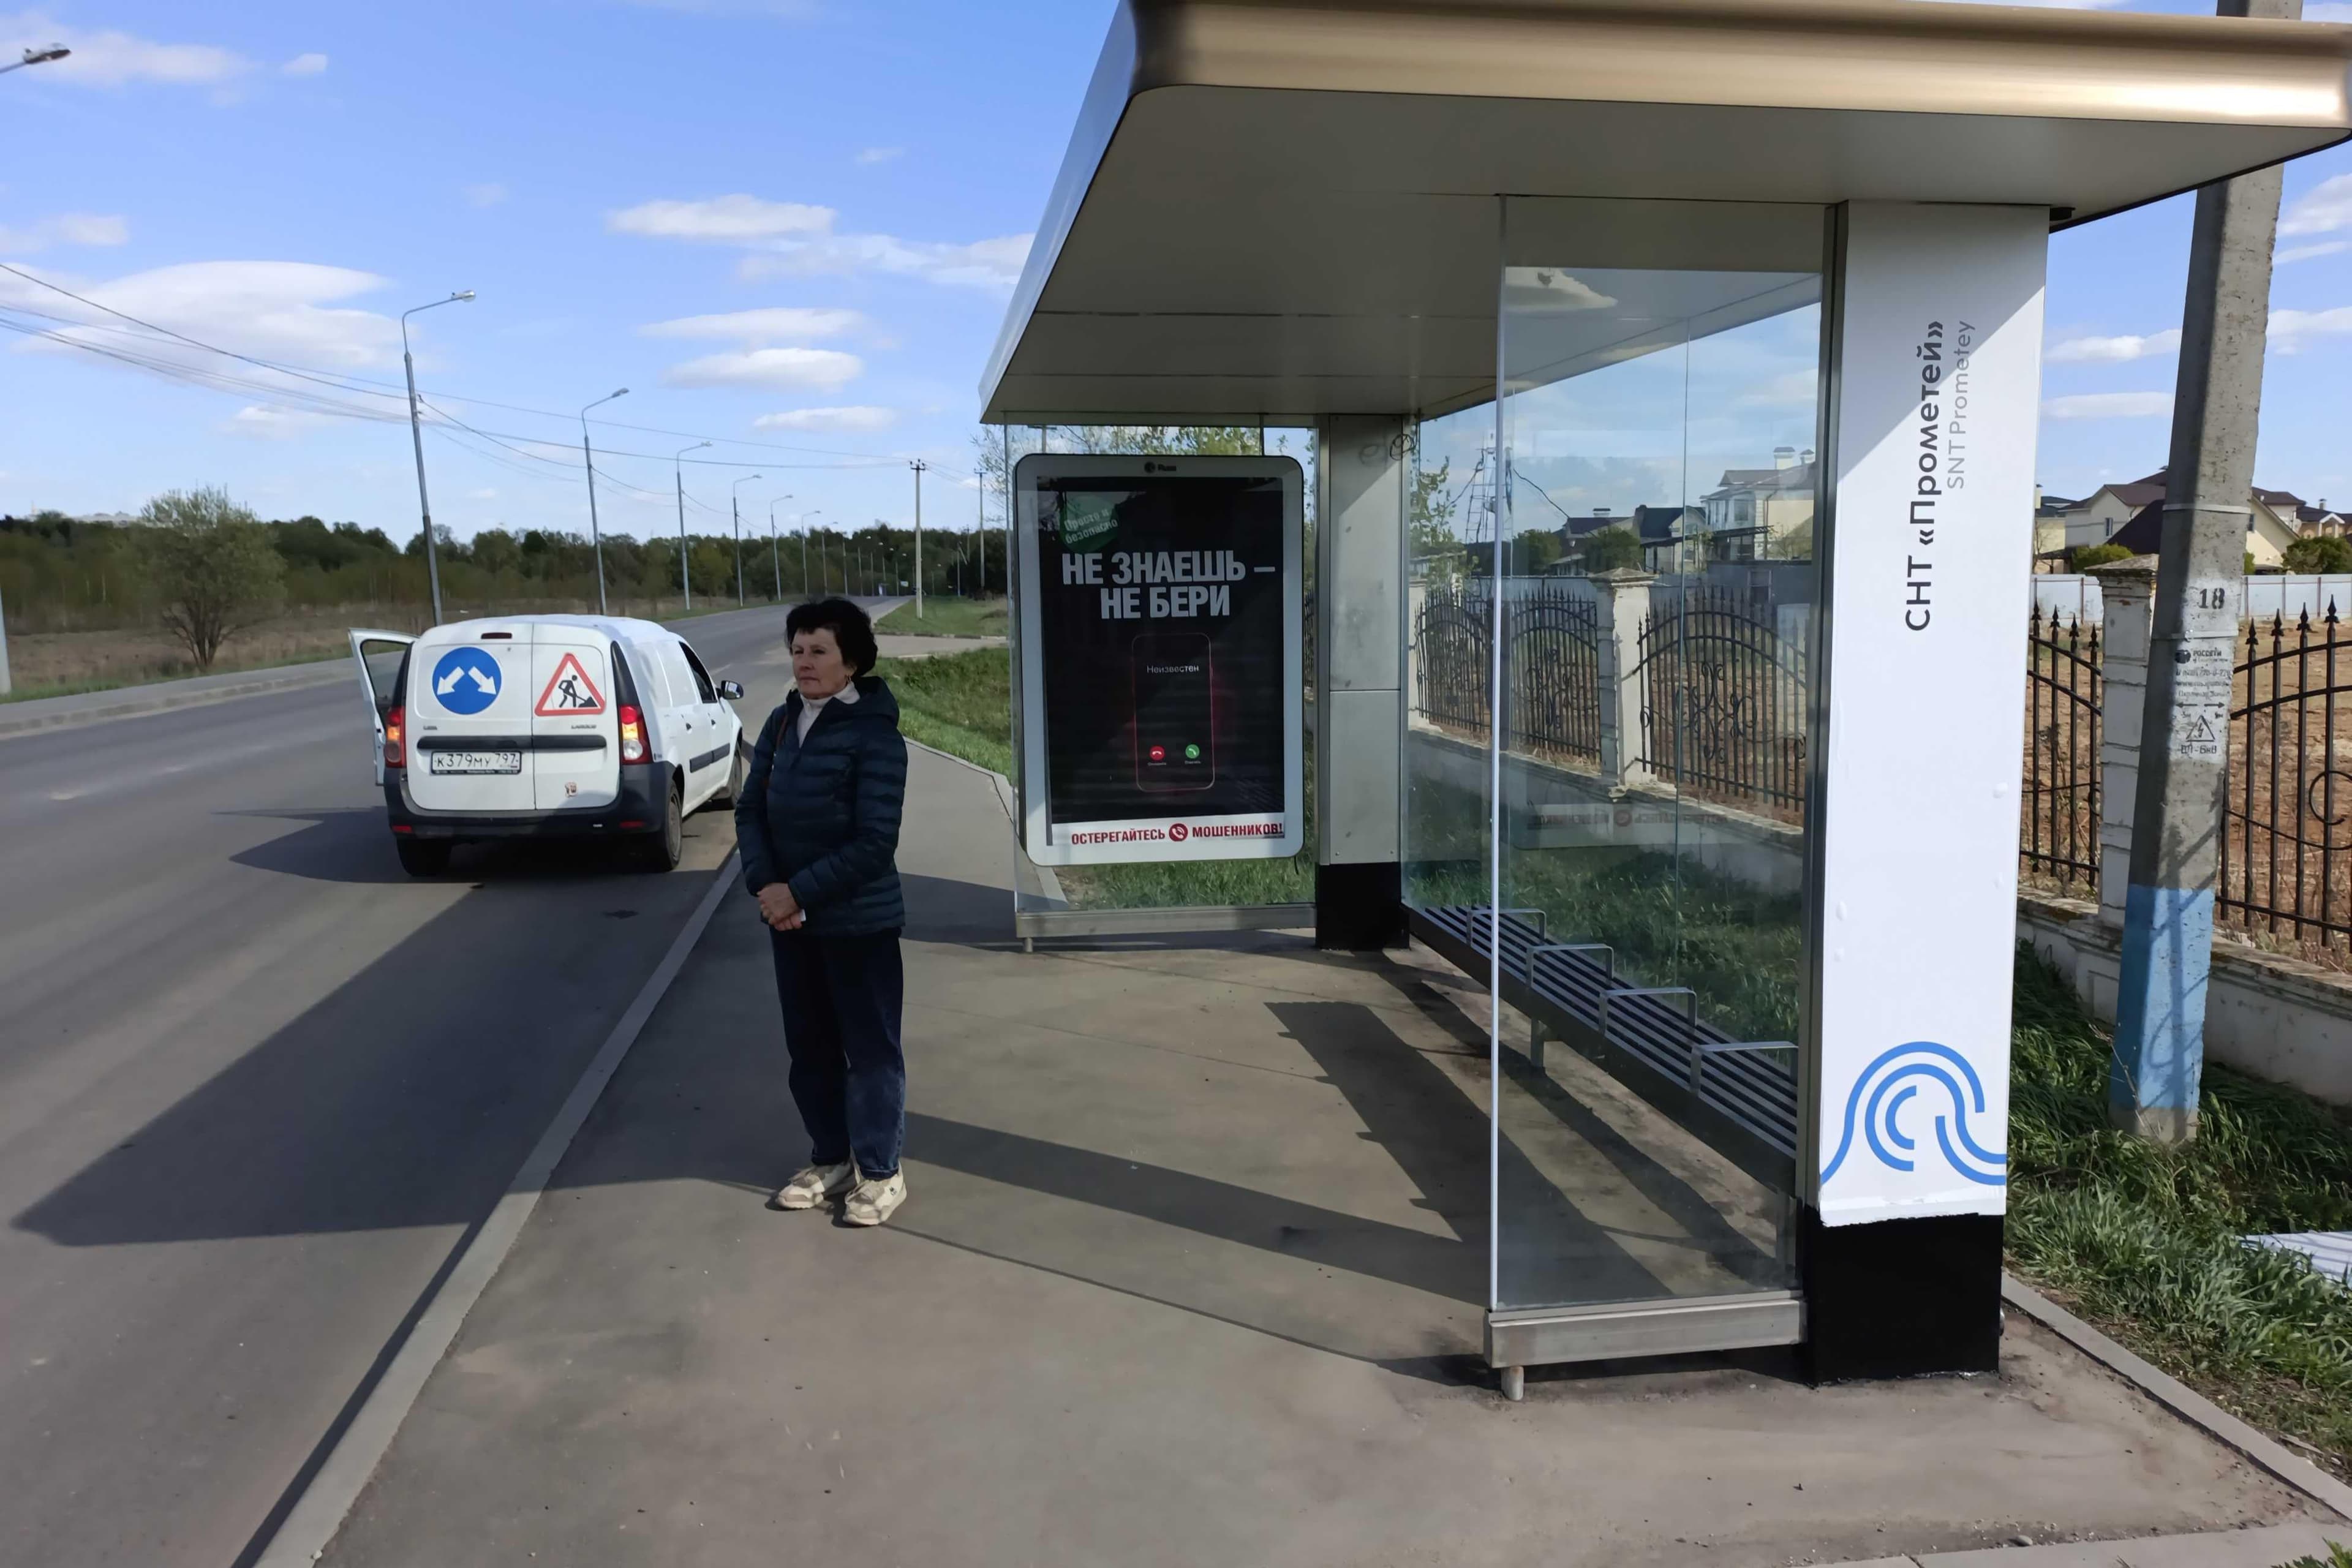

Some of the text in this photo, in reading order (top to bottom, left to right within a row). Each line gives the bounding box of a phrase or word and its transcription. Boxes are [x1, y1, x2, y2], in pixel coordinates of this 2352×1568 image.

[1947, 320, 1976, 489] SNT Prometey
[1905, 320, 1944, 631] СНТ «Прометей»
[1064, 512, 1100, 532] Просто
[1065, 519, 1118, 544] безопасно
[1061, 552, 1104, 585] НЕ
[1111, 550, 1246, 584] ЗНАЕШЬ
[1101, 585, 1231, 619] НЕ БЕРИ
[2199, 587, 2225, 609] 18
[1147, 665, 1199, 674] Неизвестен
[1071, 823, 1283, 845] ОСТЕРЕГАЙТЕСЬ МОШЕННИКОВ!
